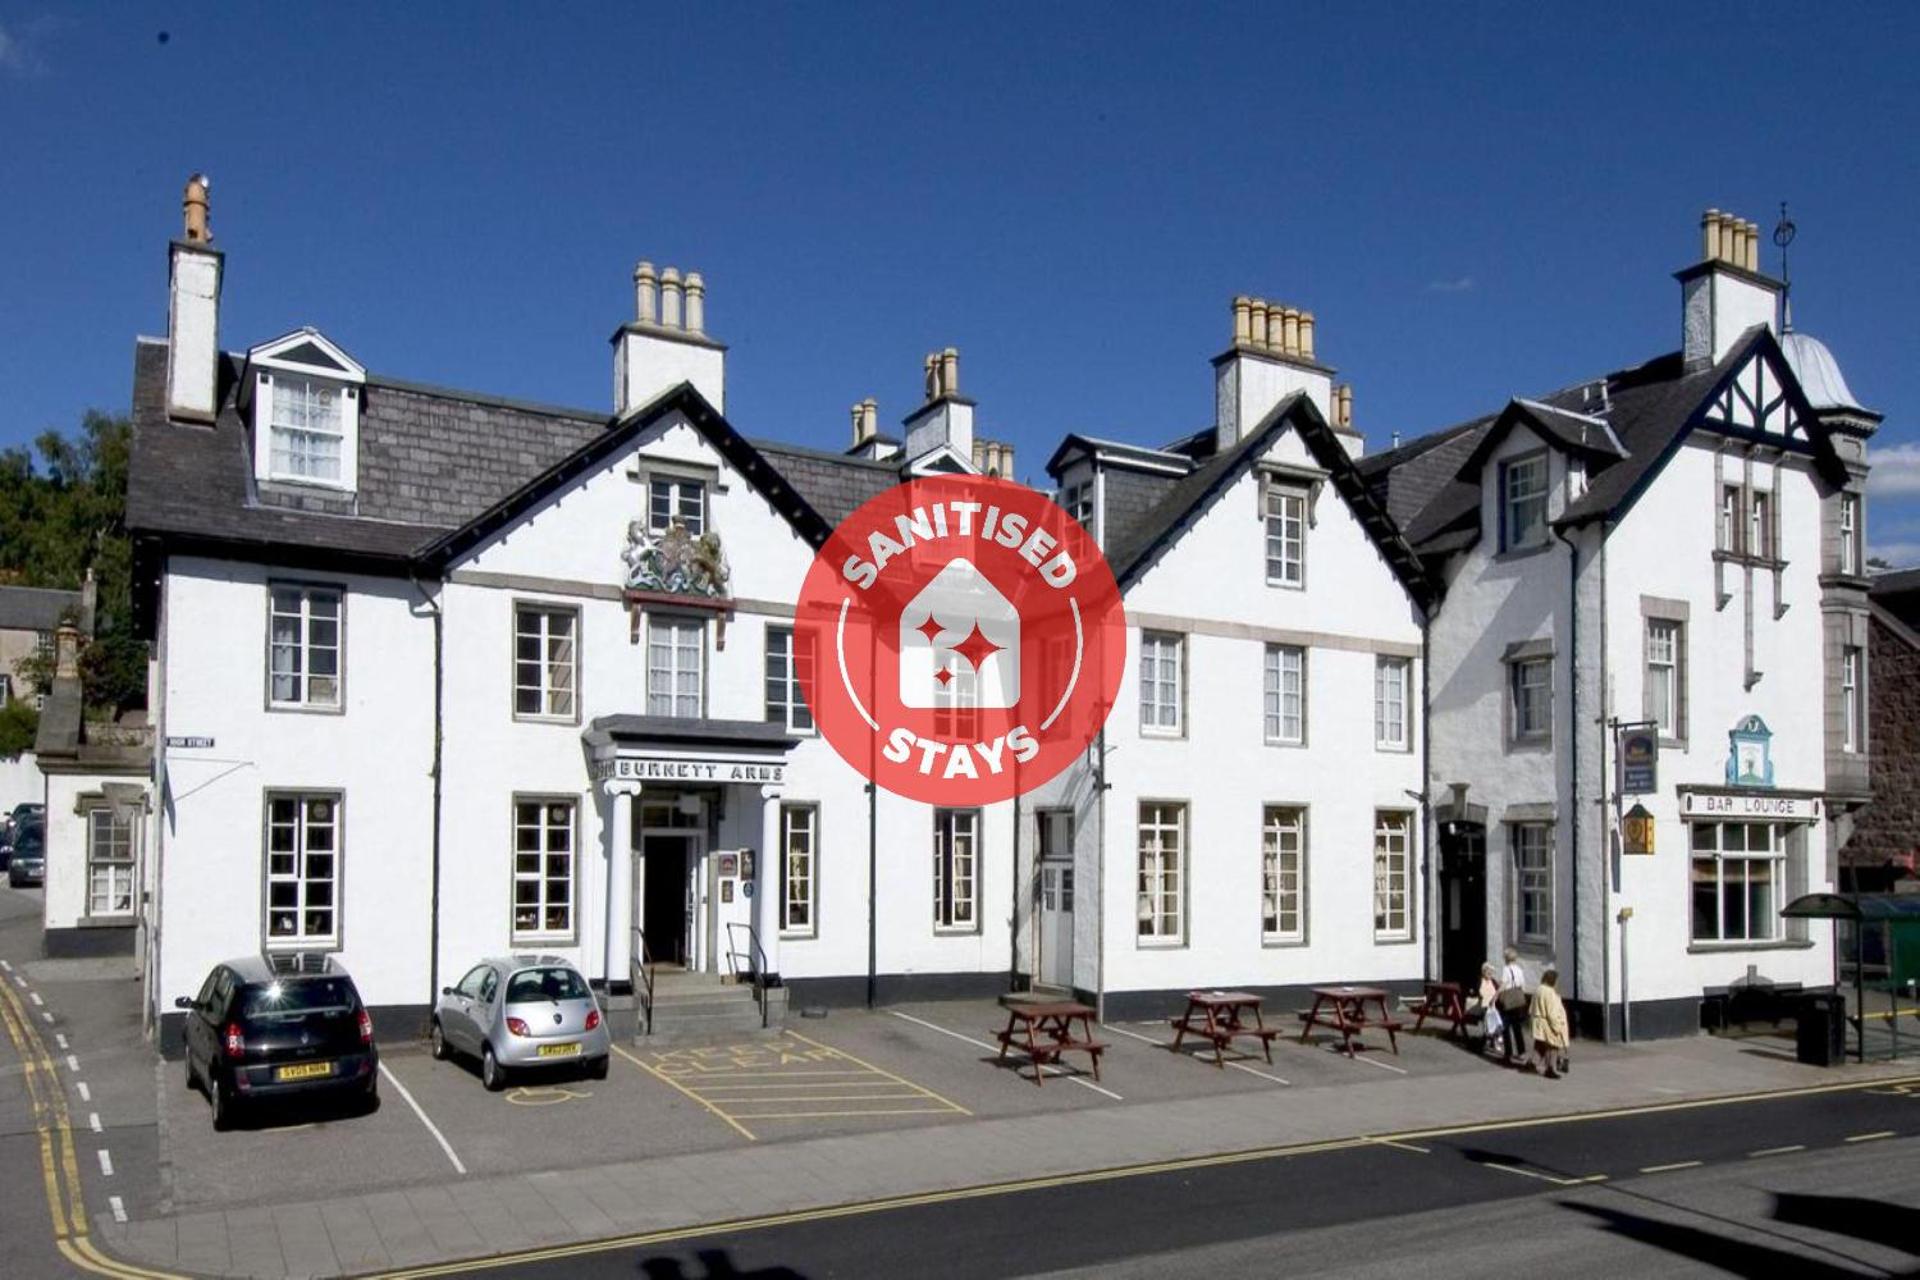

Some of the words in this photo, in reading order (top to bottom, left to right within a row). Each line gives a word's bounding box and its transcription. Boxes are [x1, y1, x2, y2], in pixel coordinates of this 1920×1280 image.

[620, 759, 717, 779] BURNETT
[730, 765, 783, 781] ARMS
[1707, 797, 1733, 811] BAR
[1745, 799, 1795, 814] LOUNGE
[655, 1050, 843, 1074] CLEAR
